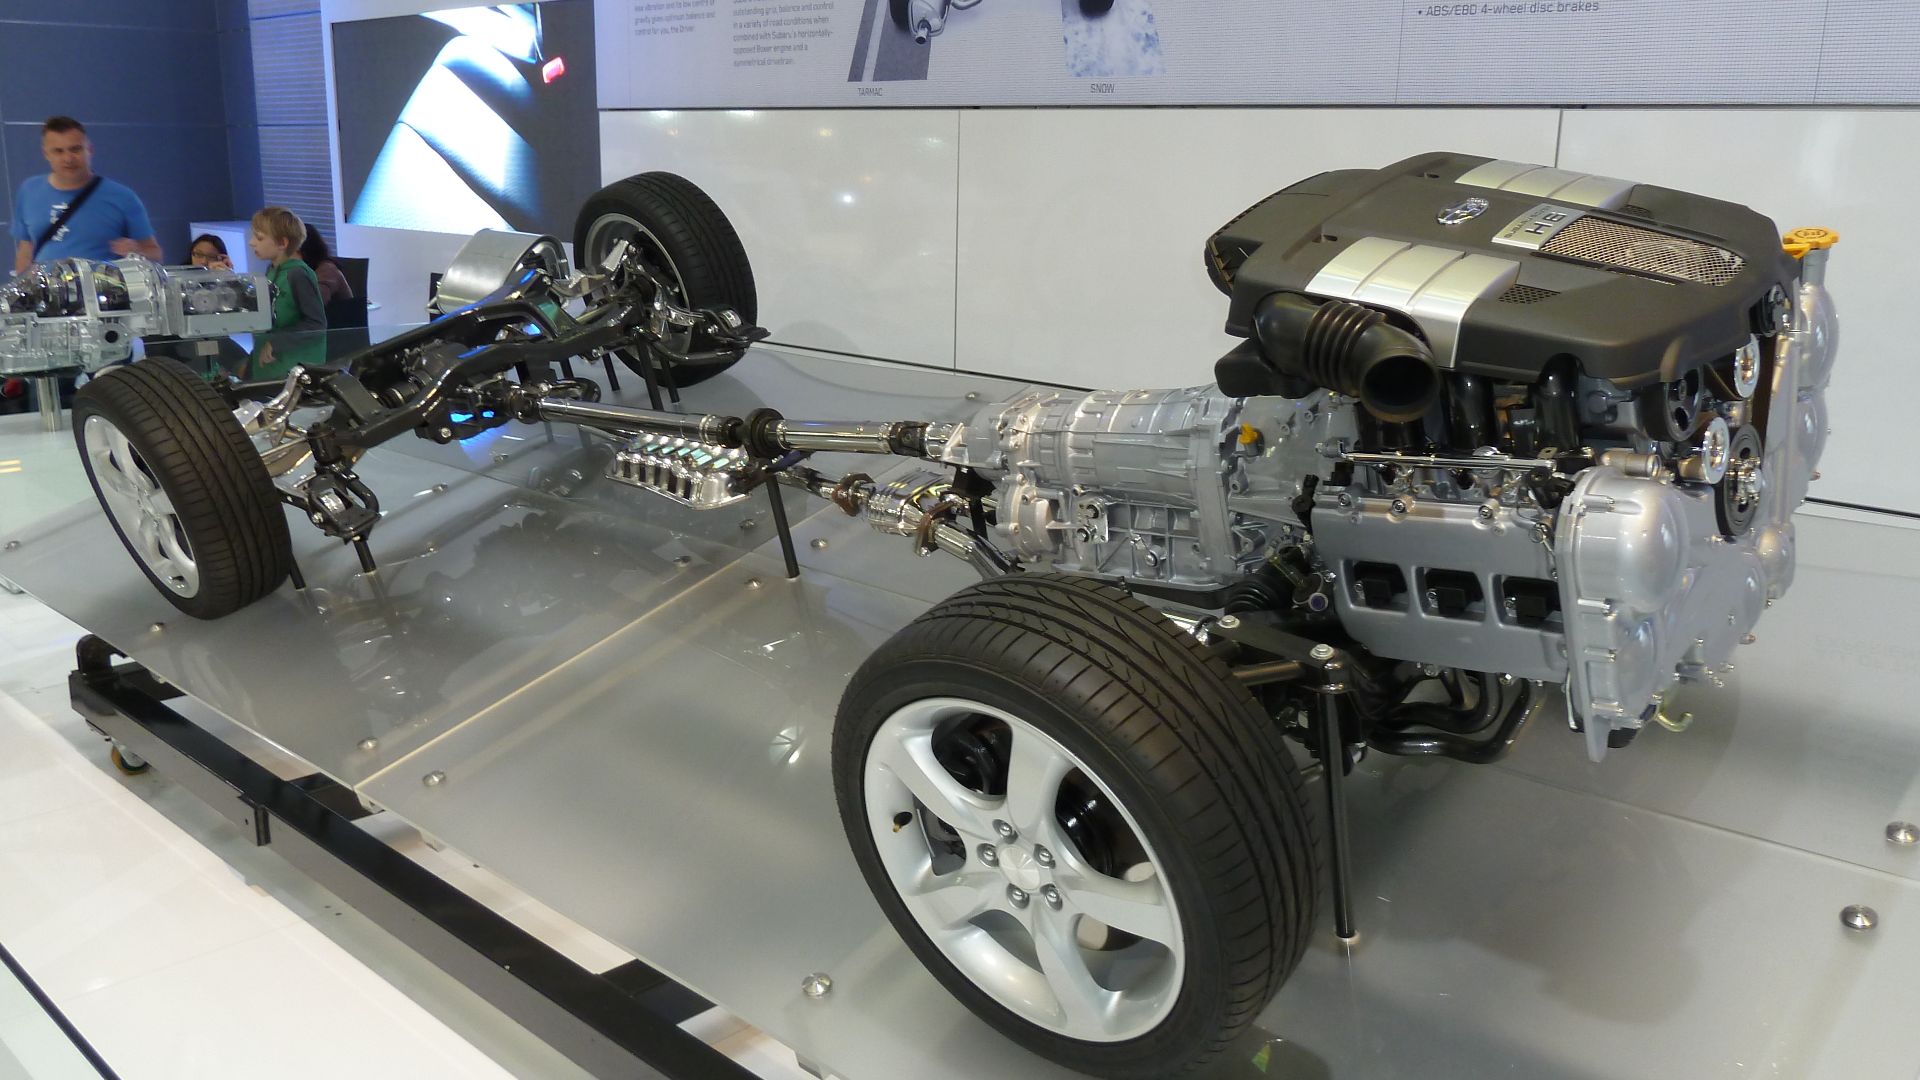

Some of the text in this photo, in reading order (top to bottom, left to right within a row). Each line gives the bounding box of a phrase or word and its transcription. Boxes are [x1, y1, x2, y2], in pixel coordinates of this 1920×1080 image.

[1426, 0, 1599, 16] ABS/EBD 4-wheel disc brakes
[857, 87, 883, 97] TARMAC
[1090, 83, 1115, 94] SNOW
